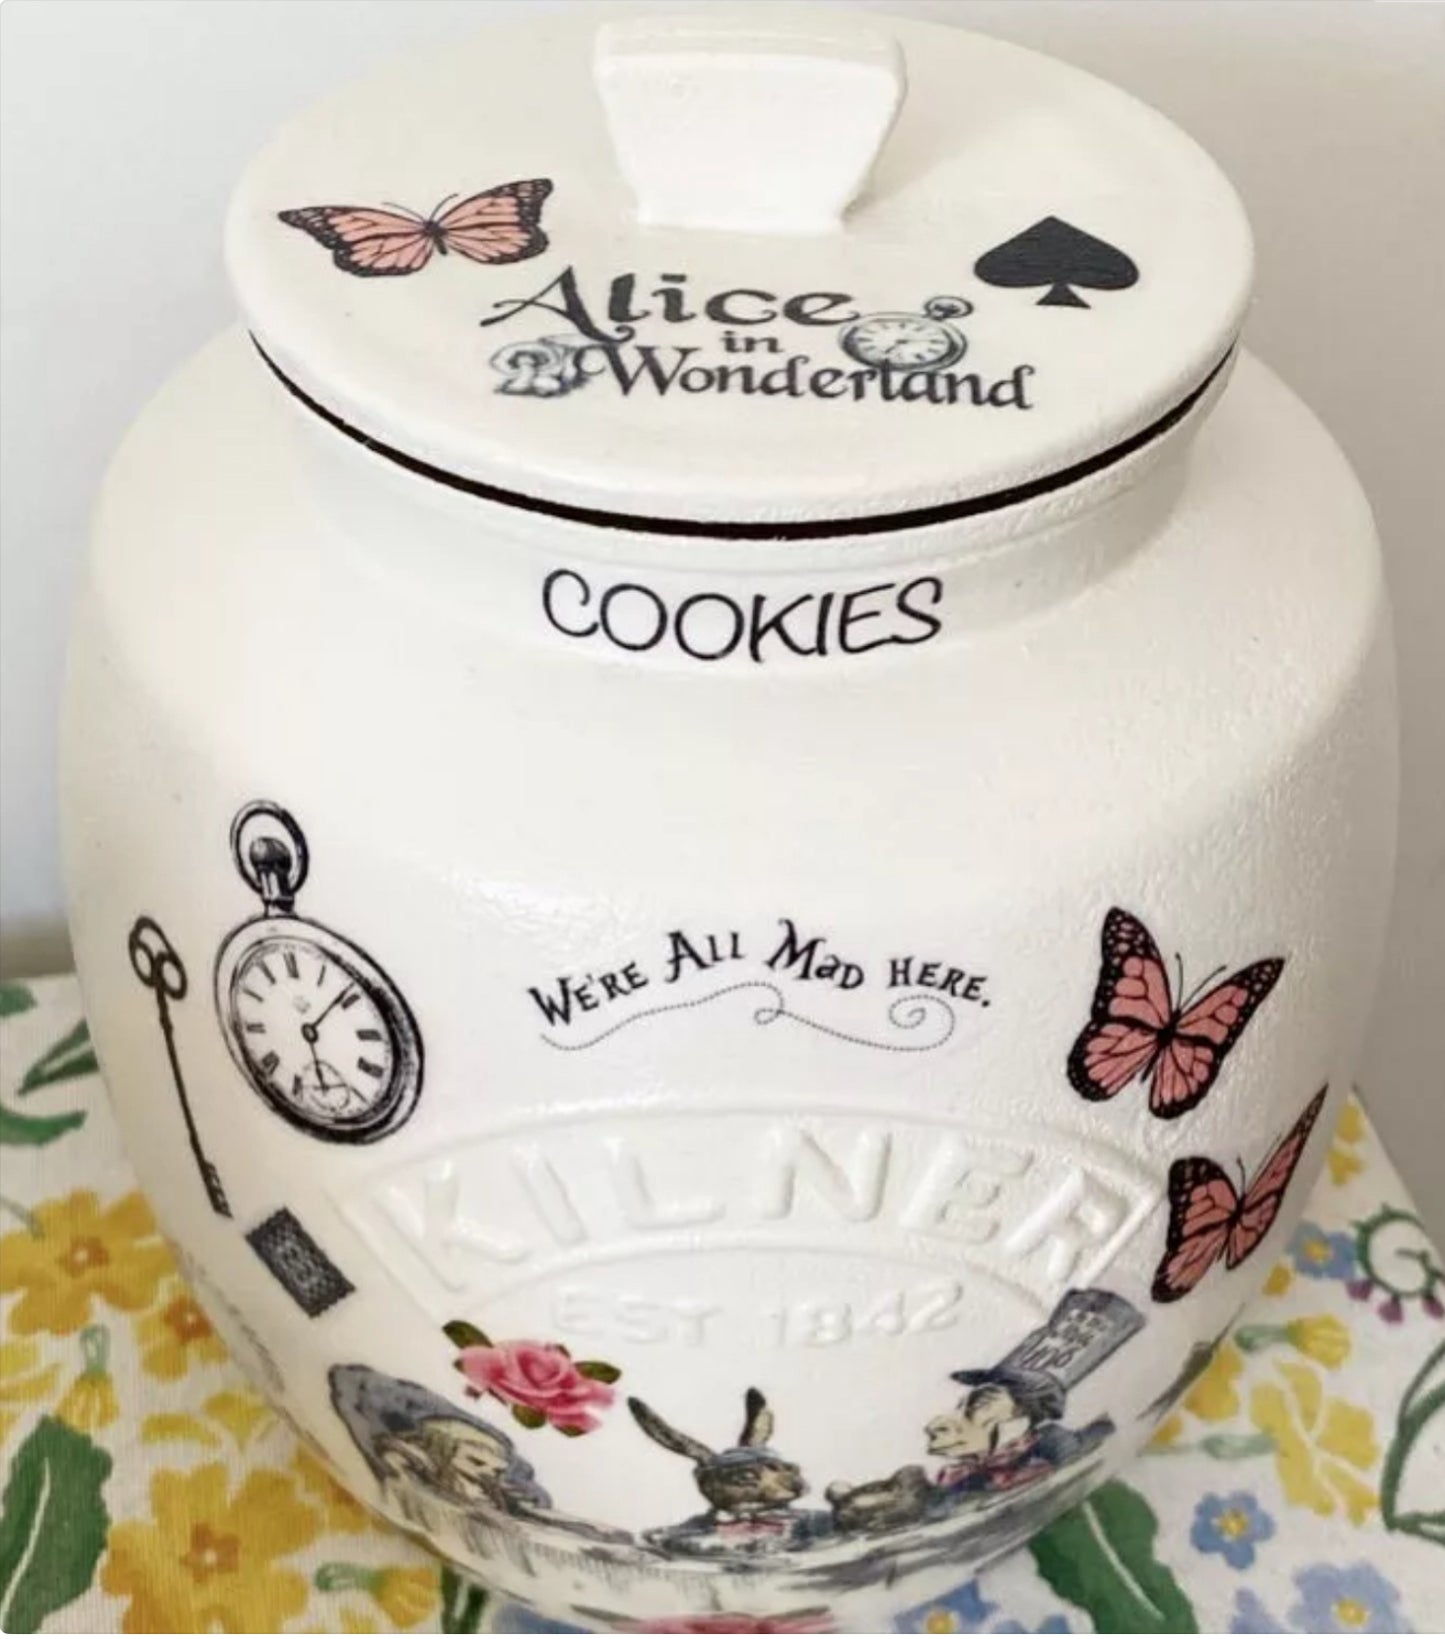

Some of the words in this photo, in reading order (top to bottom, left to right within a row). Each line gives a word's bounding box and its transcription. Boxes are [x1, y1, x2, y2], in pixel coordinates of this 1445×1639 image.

[480, 265, 859, 342] Alice
[574, 345, 1035, 410] Wonderland
[722, 330, 783, 354] in
[542, 568, 943, 663] COOKIES
[380, 1124, 1132, 1292] KILNER
[553, 1286, 722, 1346] EST
[768, 1281, 964, 1348] 1842
